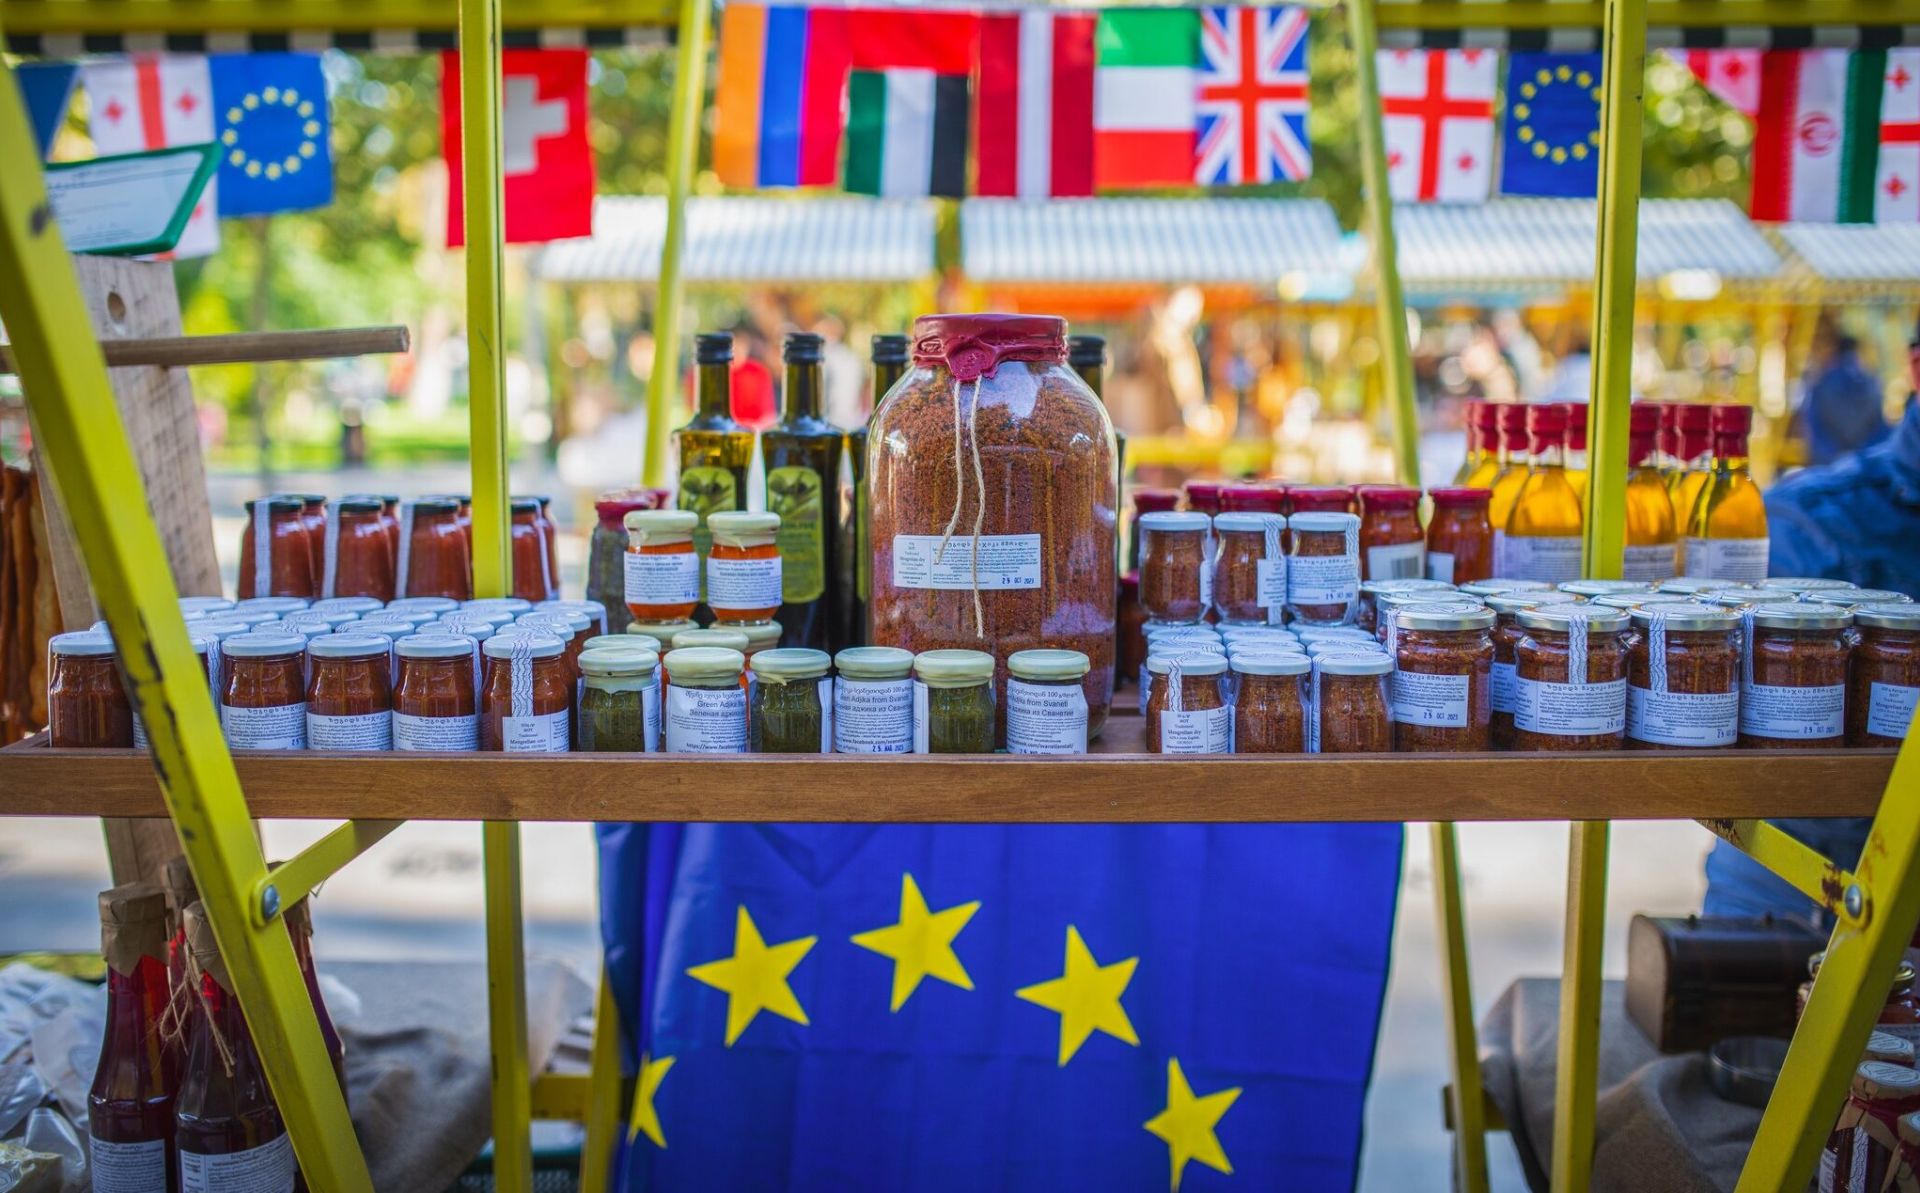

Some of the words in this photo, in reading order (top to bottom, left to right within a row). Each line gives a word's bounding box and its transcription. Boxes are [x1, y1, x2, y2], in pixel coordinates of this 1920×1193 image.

[697, 700, 718, 708] Green
[851, 696, 871, 704] Adjika
[1026, 697, 1042, 706] from
[1043, 699, 1069, 708] Svaneti
